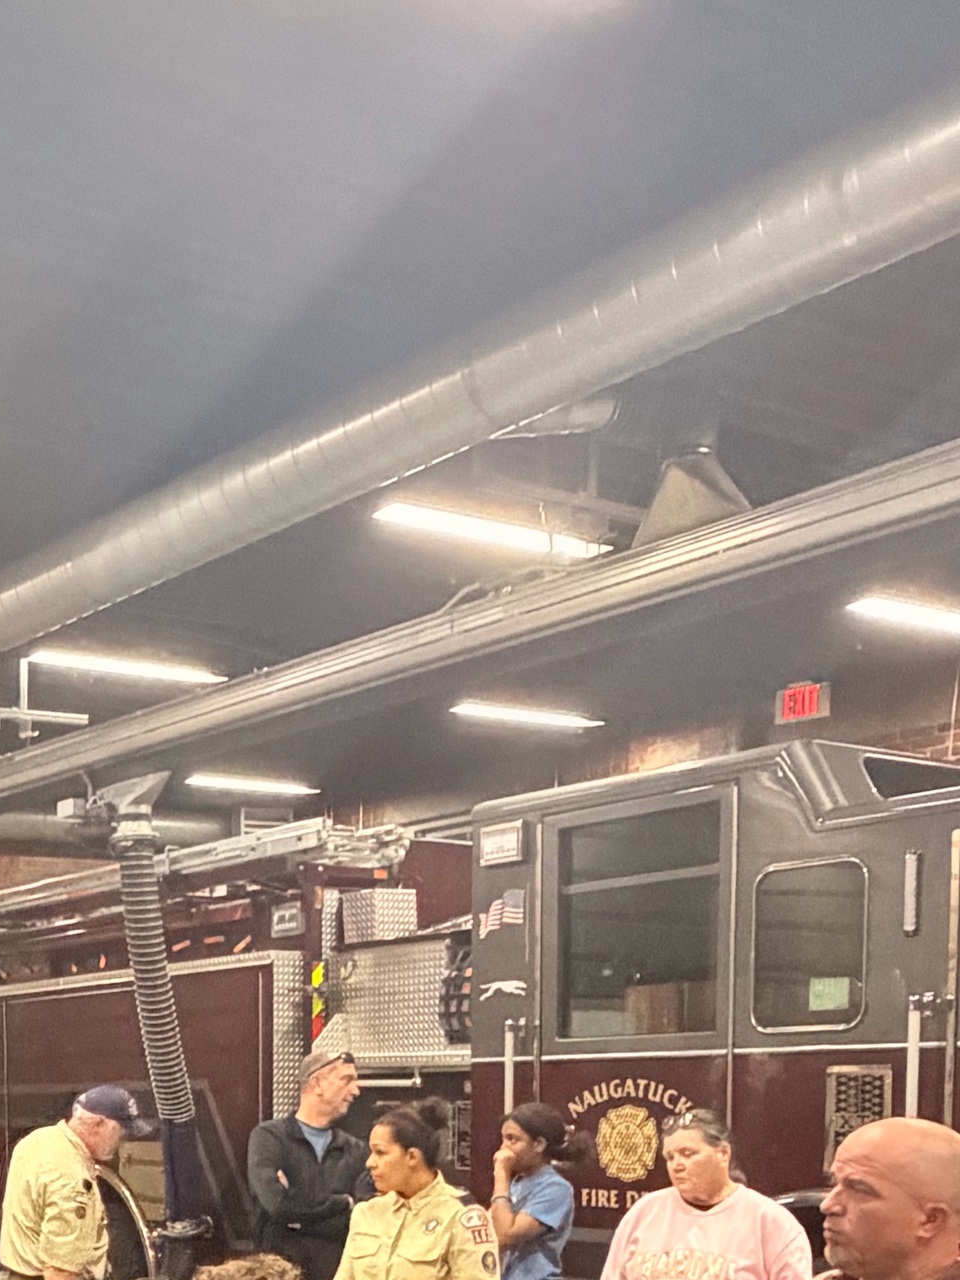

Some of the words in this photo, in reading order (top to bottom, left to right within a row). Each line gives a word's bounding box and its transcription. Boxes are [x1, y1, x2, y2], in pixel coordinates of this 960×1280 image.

[782, 684, 820, 720] EXIT
[567, 1078, 693, 1119] NAUGATUCK
[581, 1188, 620, 1209] FIRE
